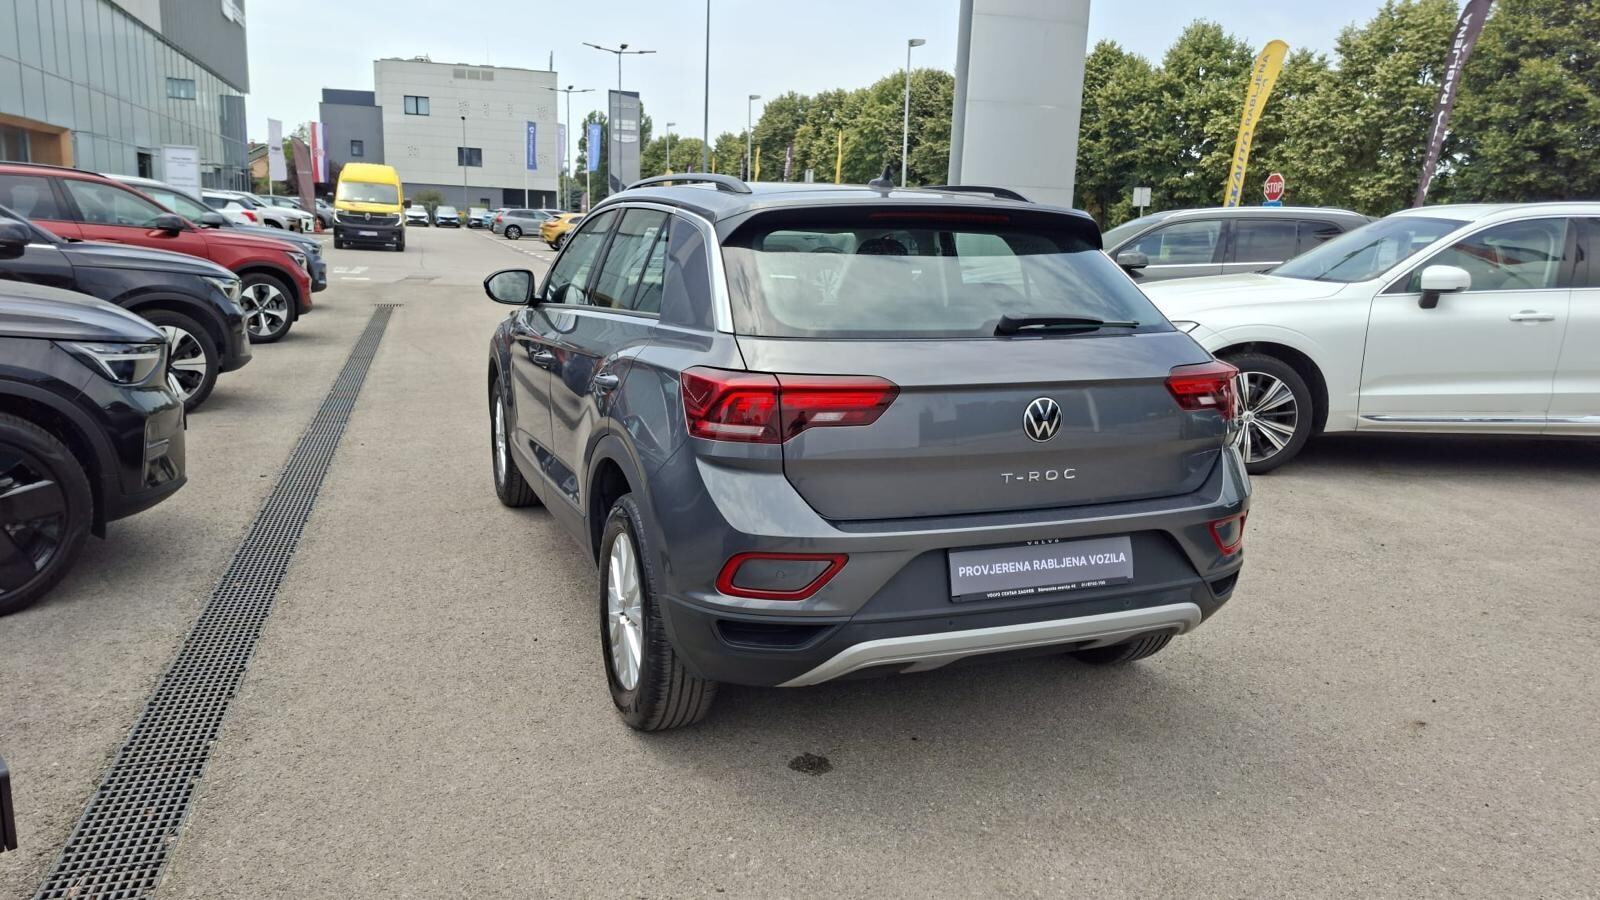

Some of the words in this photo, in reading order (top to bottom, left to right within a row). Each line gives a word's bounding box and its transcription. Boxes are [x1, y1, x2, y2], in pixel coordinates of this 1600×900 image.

[1440, 13, 1473, 105] RABLJENA
[1244, 54, 1271, 126] RABLJENA
[1265, 182, 1283, 194] STOP
[1001, 468, 1076, 484] T-ROC
[958, 560, 1031, 577] PROVJERENA
[1033, 554, 1087, 570] RABLJENA
[1088, 552, 1126, 566] VOZILA
